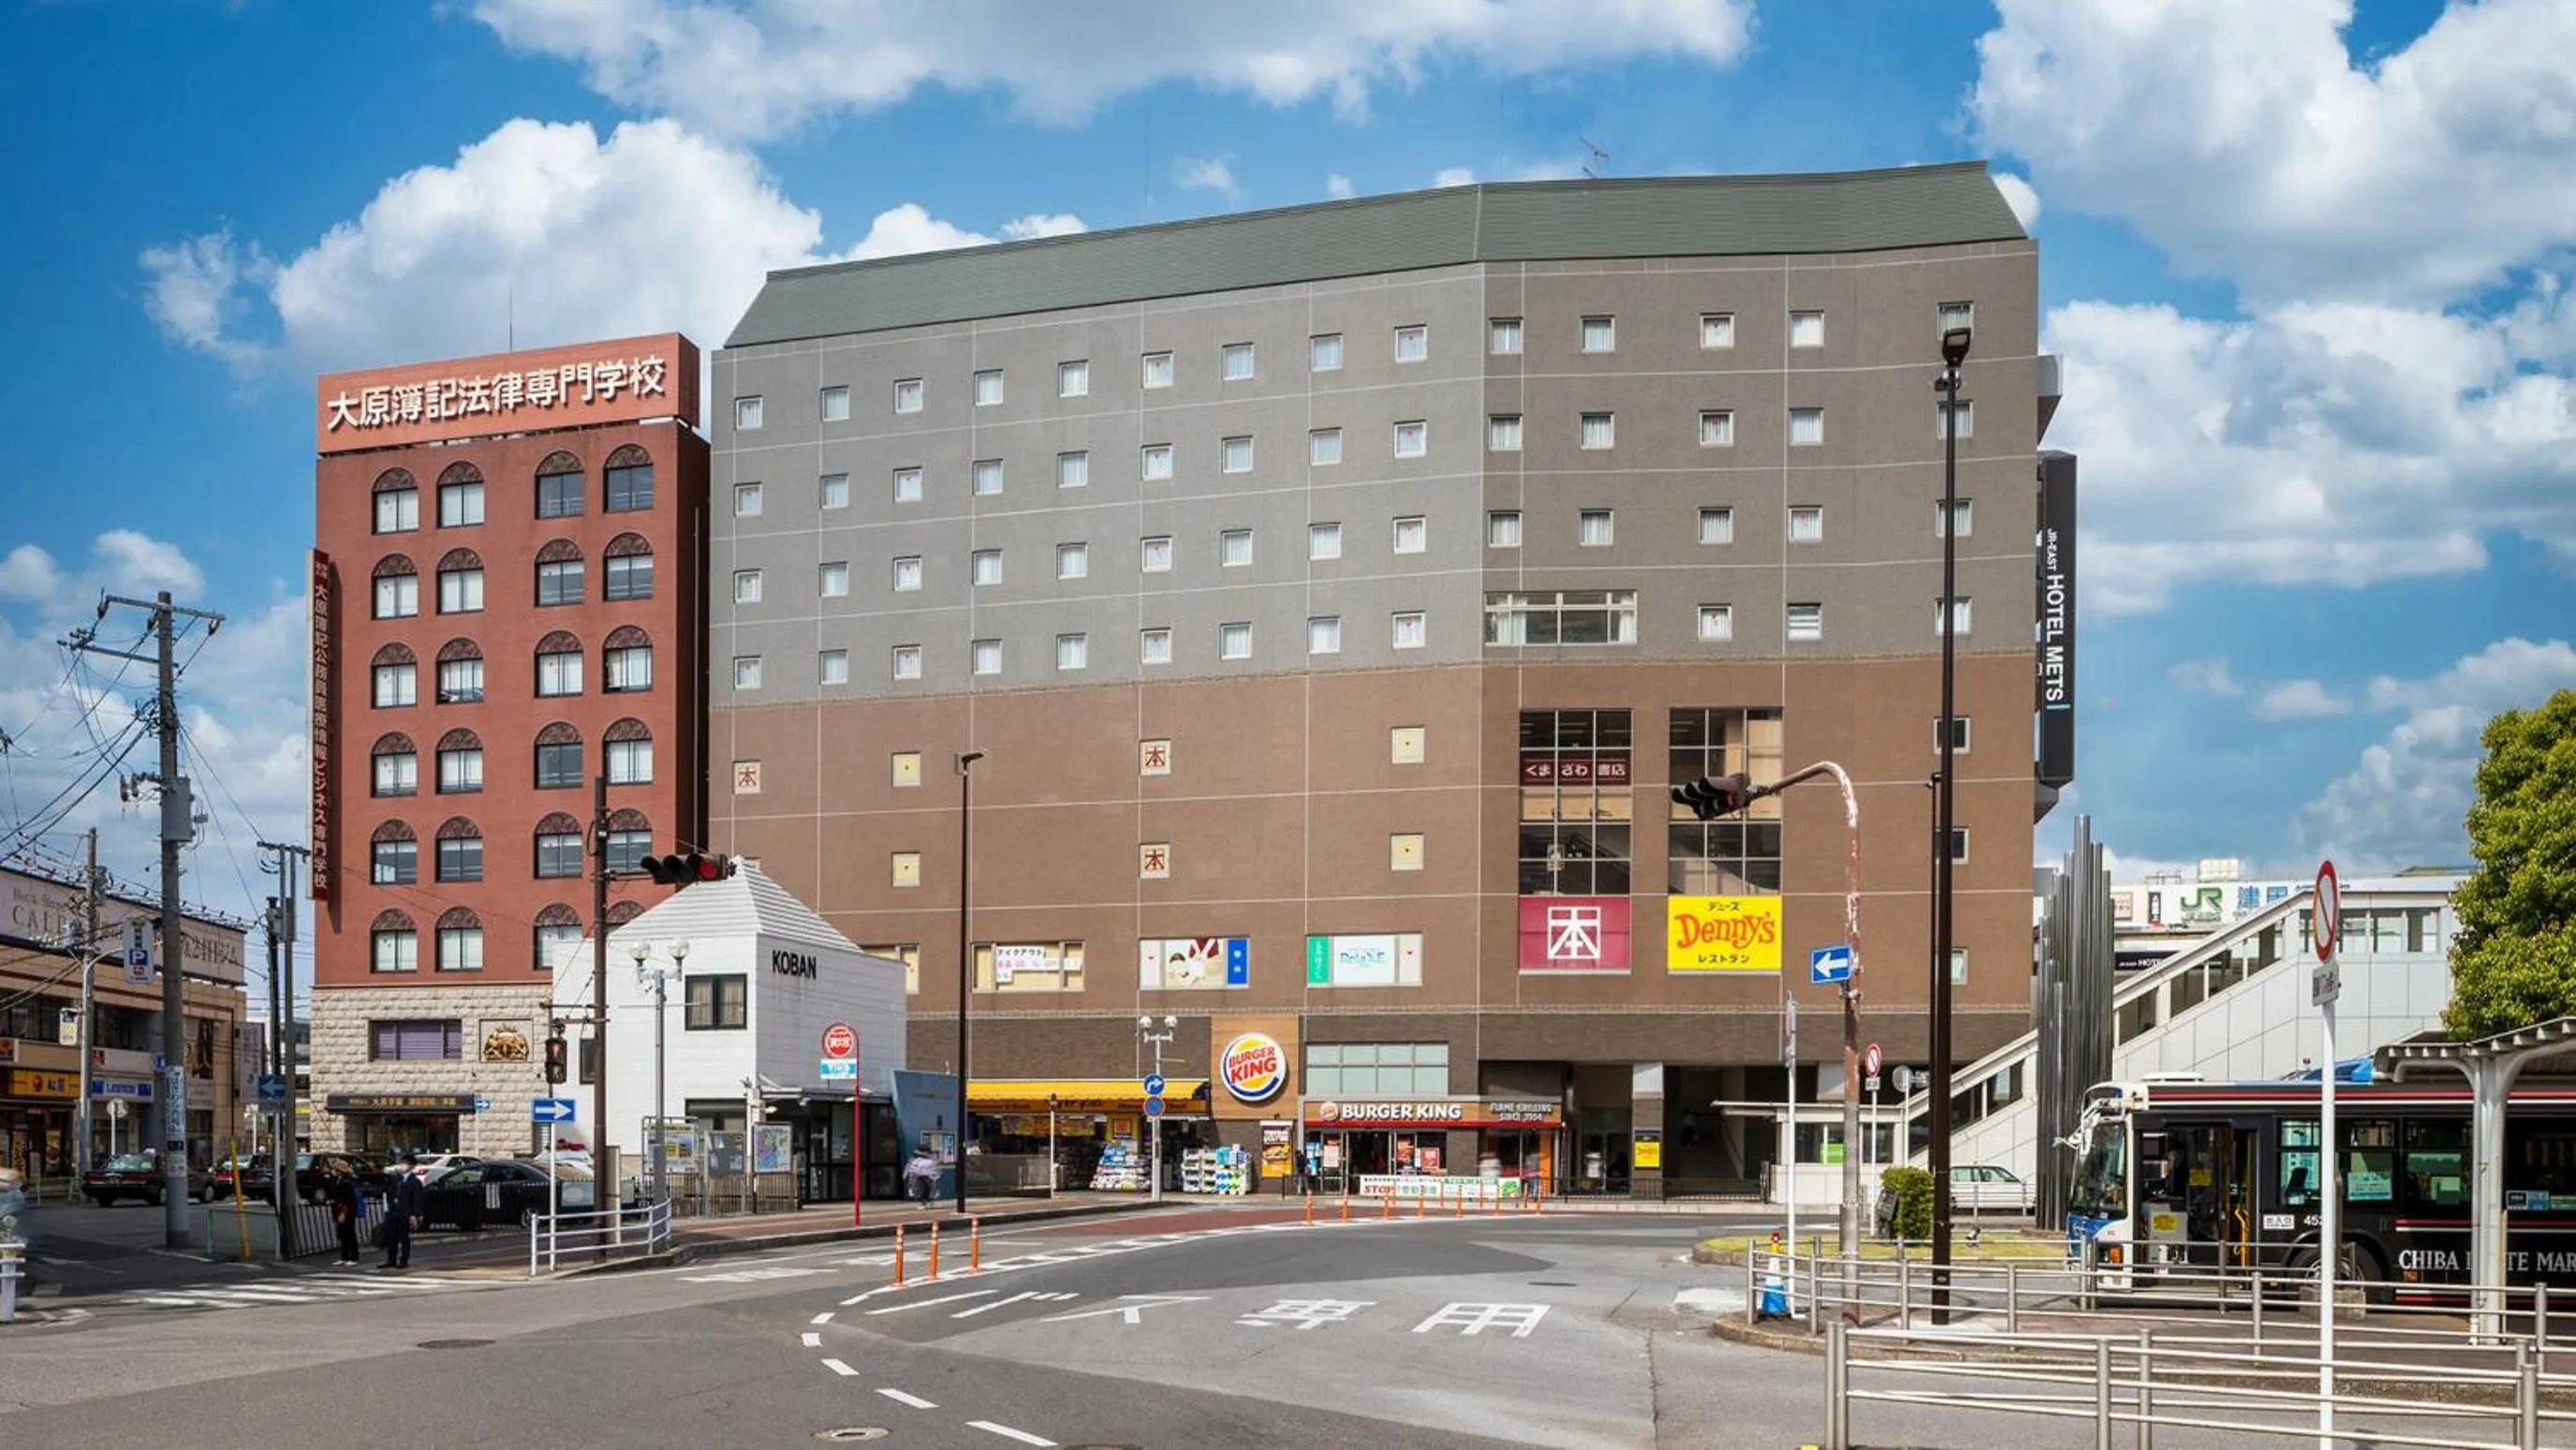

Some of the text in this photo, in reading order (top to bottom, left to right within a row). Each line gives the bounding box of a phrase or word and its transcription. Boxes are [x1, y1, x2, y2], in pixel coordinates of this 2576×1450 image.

[328, 355, 668, 431] 大原簿記法律専門学校
[2046, 528, 2065, 702] JR-EAST HOTEL METS
[1525, 762, 1627, 777] くまざわ書店
[2181, 887, 2223, 909] JR
[1674, 911, 1775, 950] Denny's
[132, 951, 145, 963] P
[773, 949, 817, 981] KOBAN
[1698, 954, 1750, 964] レストラン
[1229, 1046, 1275, 1068] BURGER
[1230, 1058, 1277, 1085] KING
[1342, 1103, 1462, 1119] BURGER KING
[2399, 1250, 2460, 1270] CHIBA
[863, 1290, 1552, 1337] バス専用
